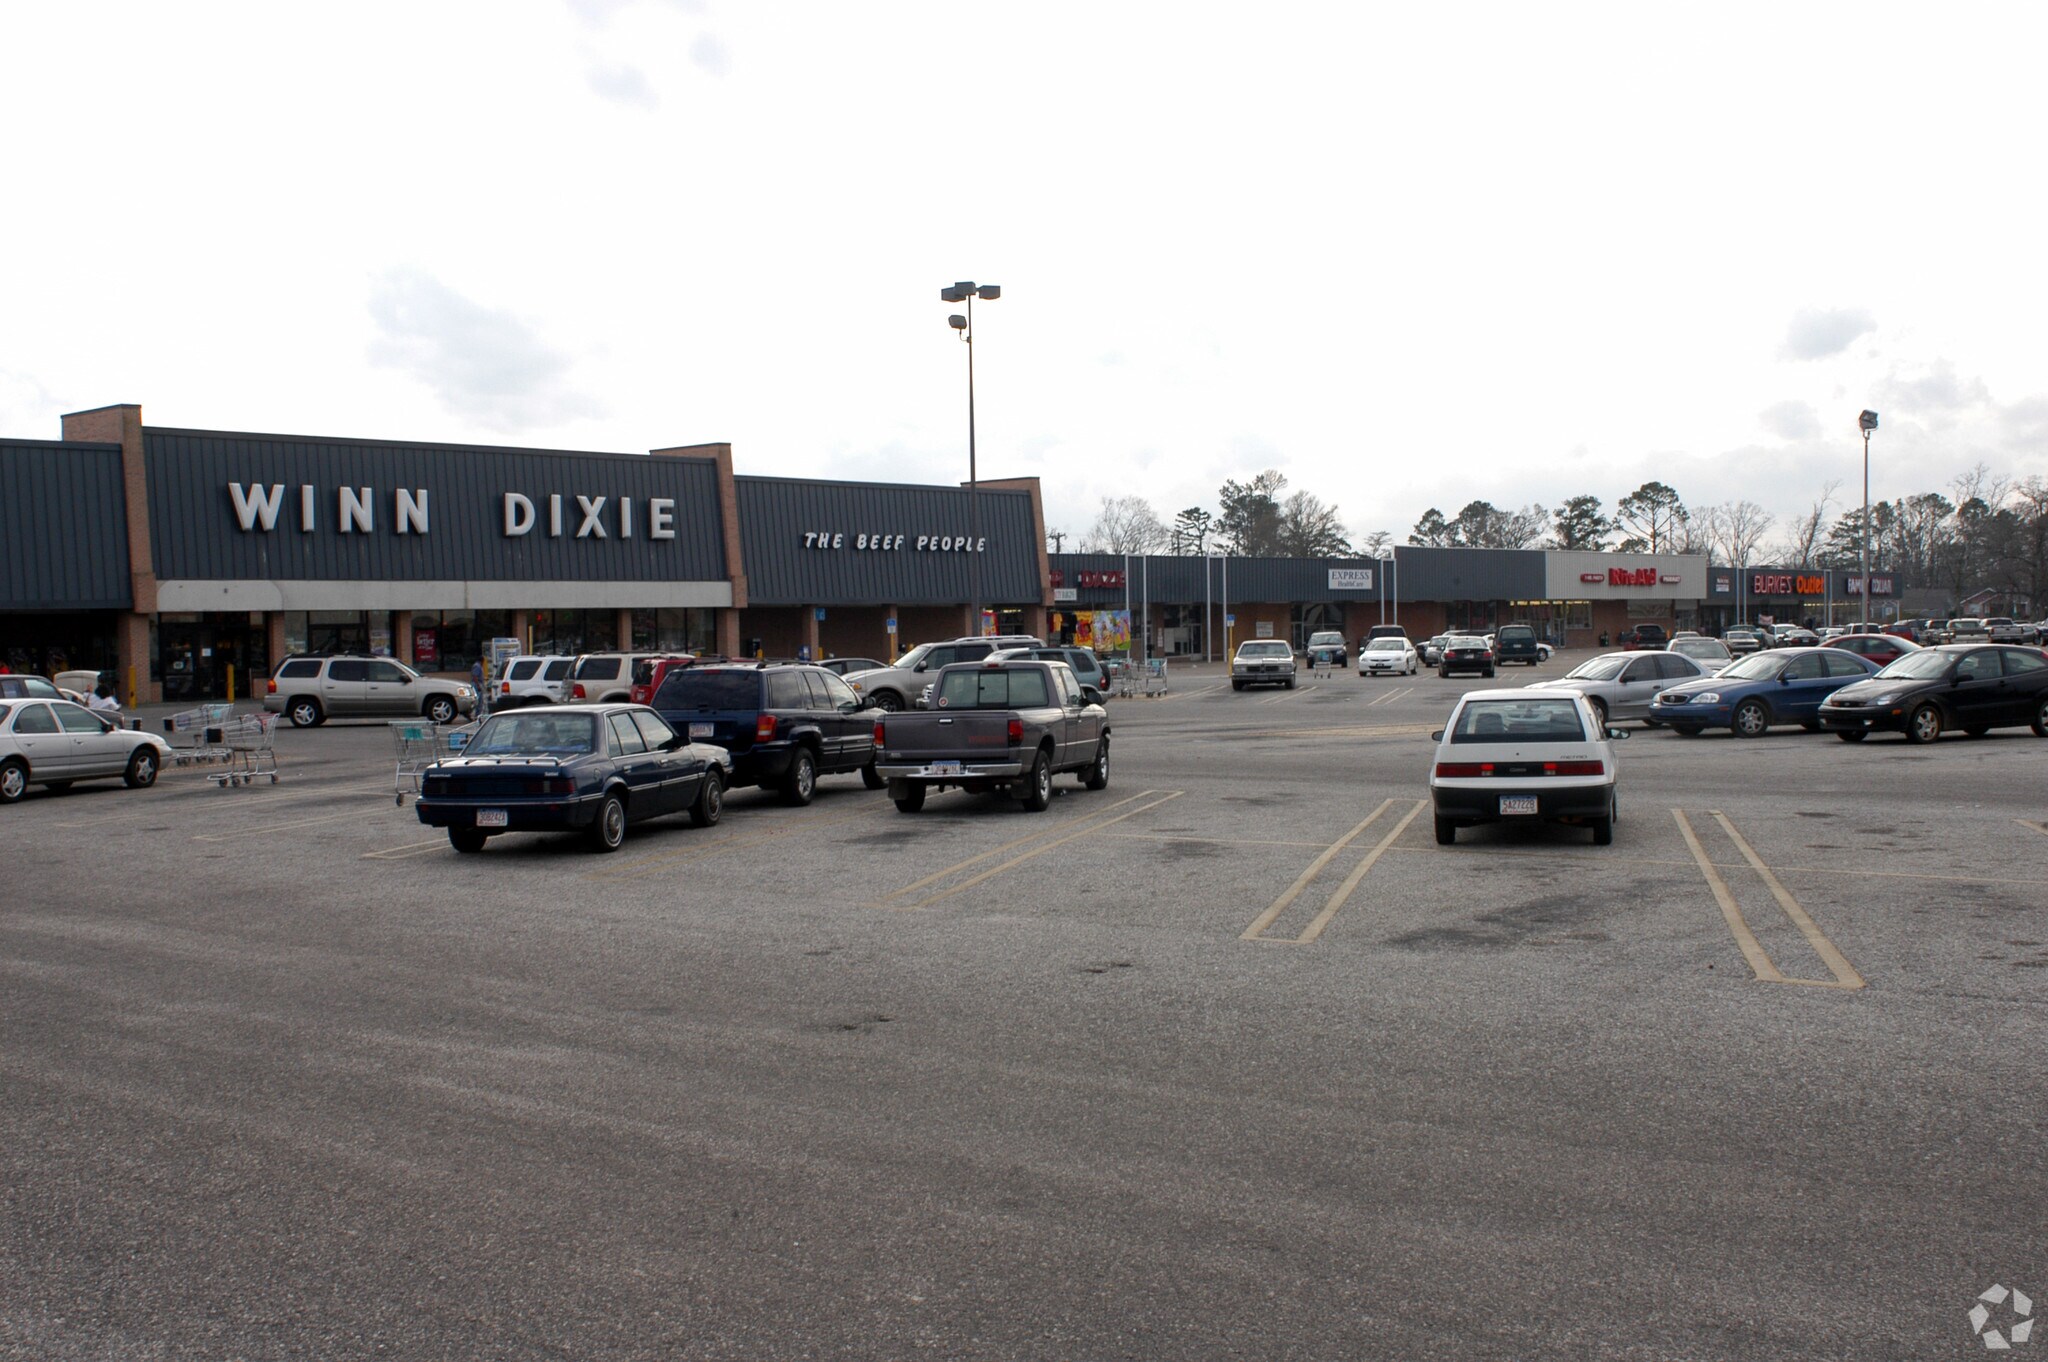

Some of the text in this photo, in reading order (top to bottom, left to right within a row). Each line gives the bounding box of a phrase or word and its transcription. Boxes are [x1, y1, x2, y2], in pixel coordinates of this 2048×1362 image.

[227, 481, 676, 541] WINN DIXIE
[804, 531, 986, 553] THE BEEF PEOPLE
[1331, 570, 1370, 580] EXPRESS
[1795, 575, 1825, 594] Outlet
